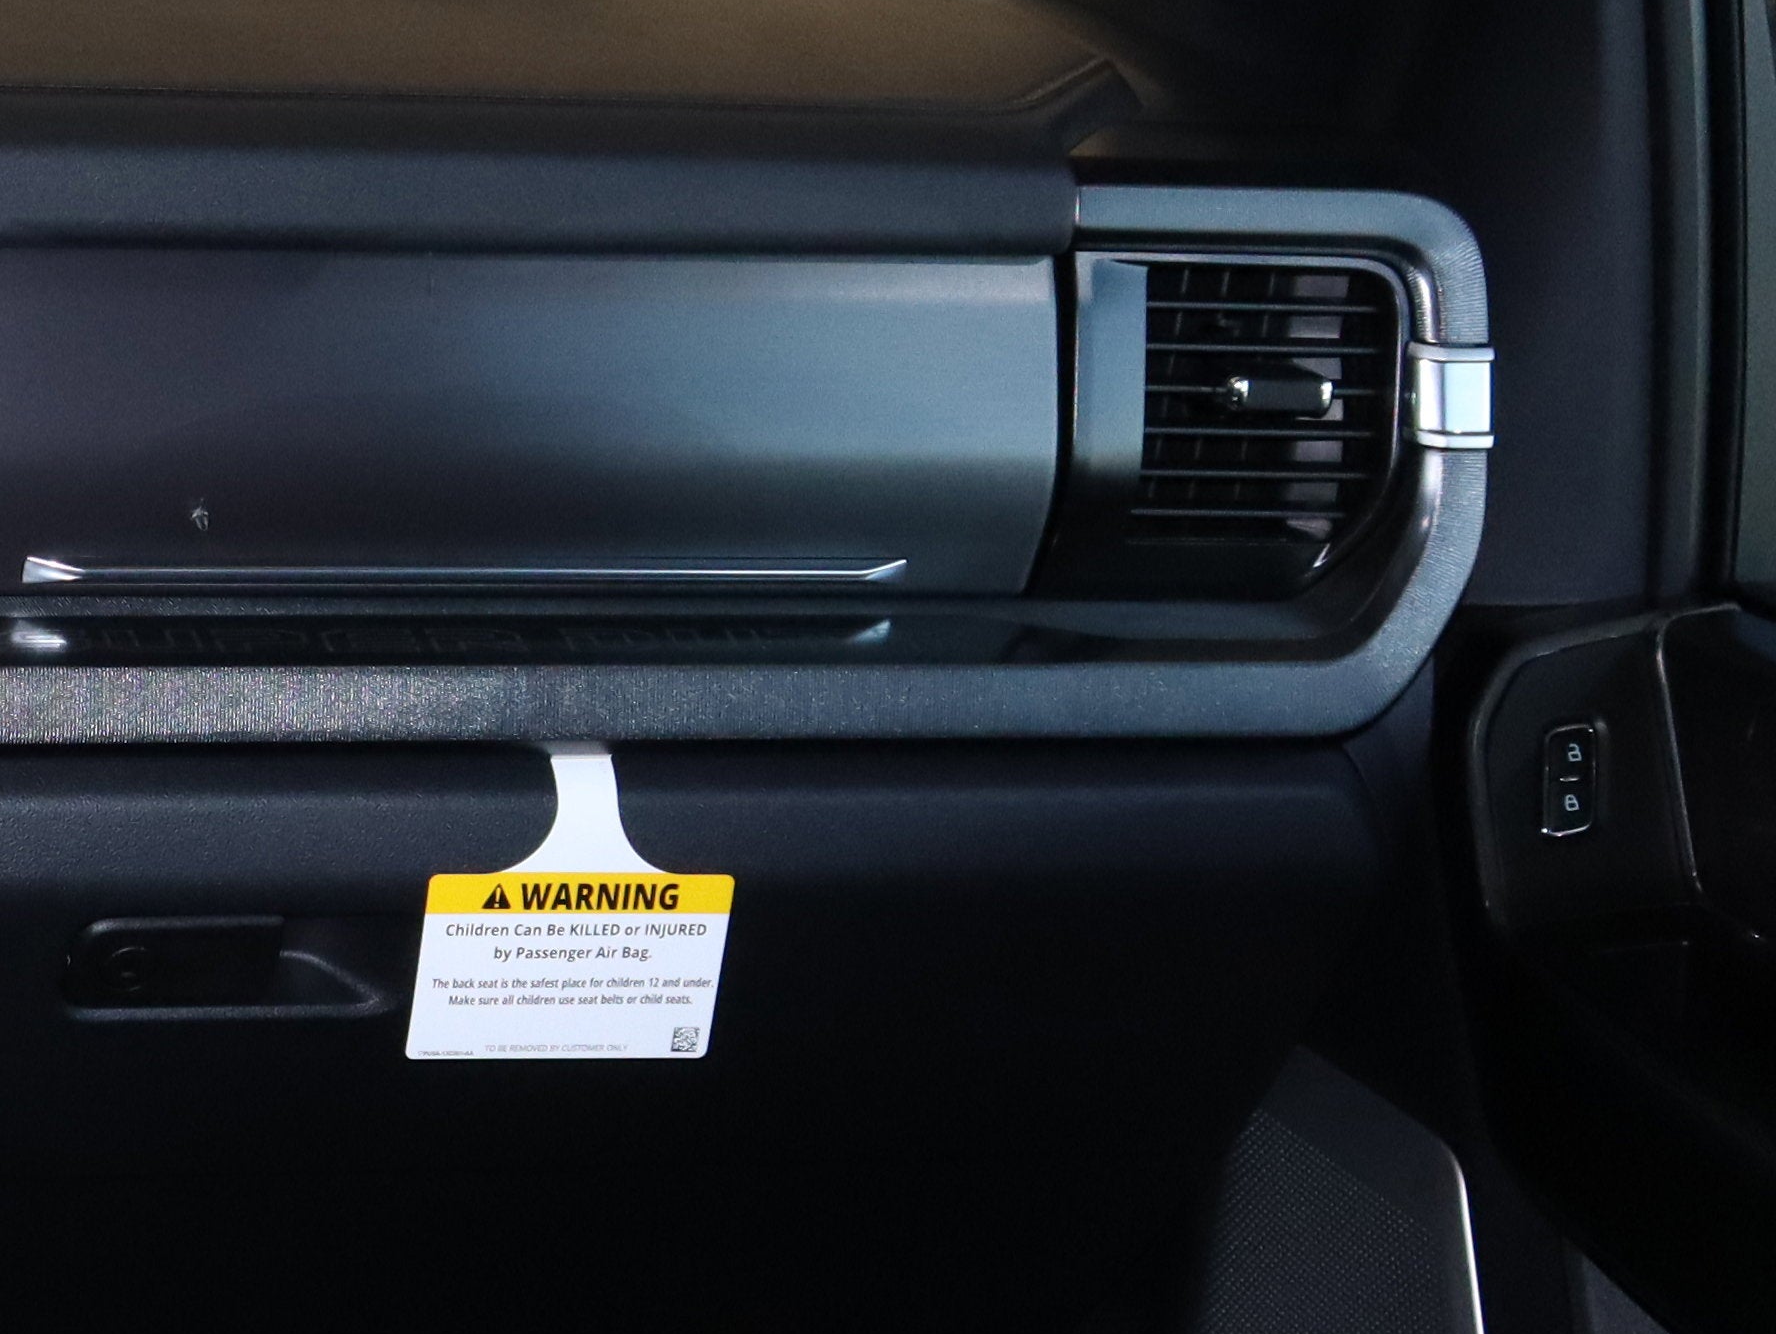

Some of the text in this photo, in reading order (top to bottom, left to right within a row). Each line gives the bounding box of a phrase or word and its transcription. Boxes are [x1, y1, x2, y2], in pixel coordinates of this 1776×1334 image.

[521, 883, 680, 910] WARNING
[446, 924, 707, 939] Children Can Be KILLED or INJURED
[494, 947, 652, 962] by Passenger Air Bag.
[433, 978, 714, 990] The back seat is the safest place for children 12 and under.
[448, 995, 475, 1005] Make
[478, 997, 499, 1005] sure
[502, 995, 514, 1005] all
[517, 995, 556, 1005] children
[559, 997, 575, 1005] use
[578, 995, 598, 1005] seat
[601, 995, 623, 1005] belts
[640, 994, 662, 1004] child
[665, 995, 693, 1005] seats.
